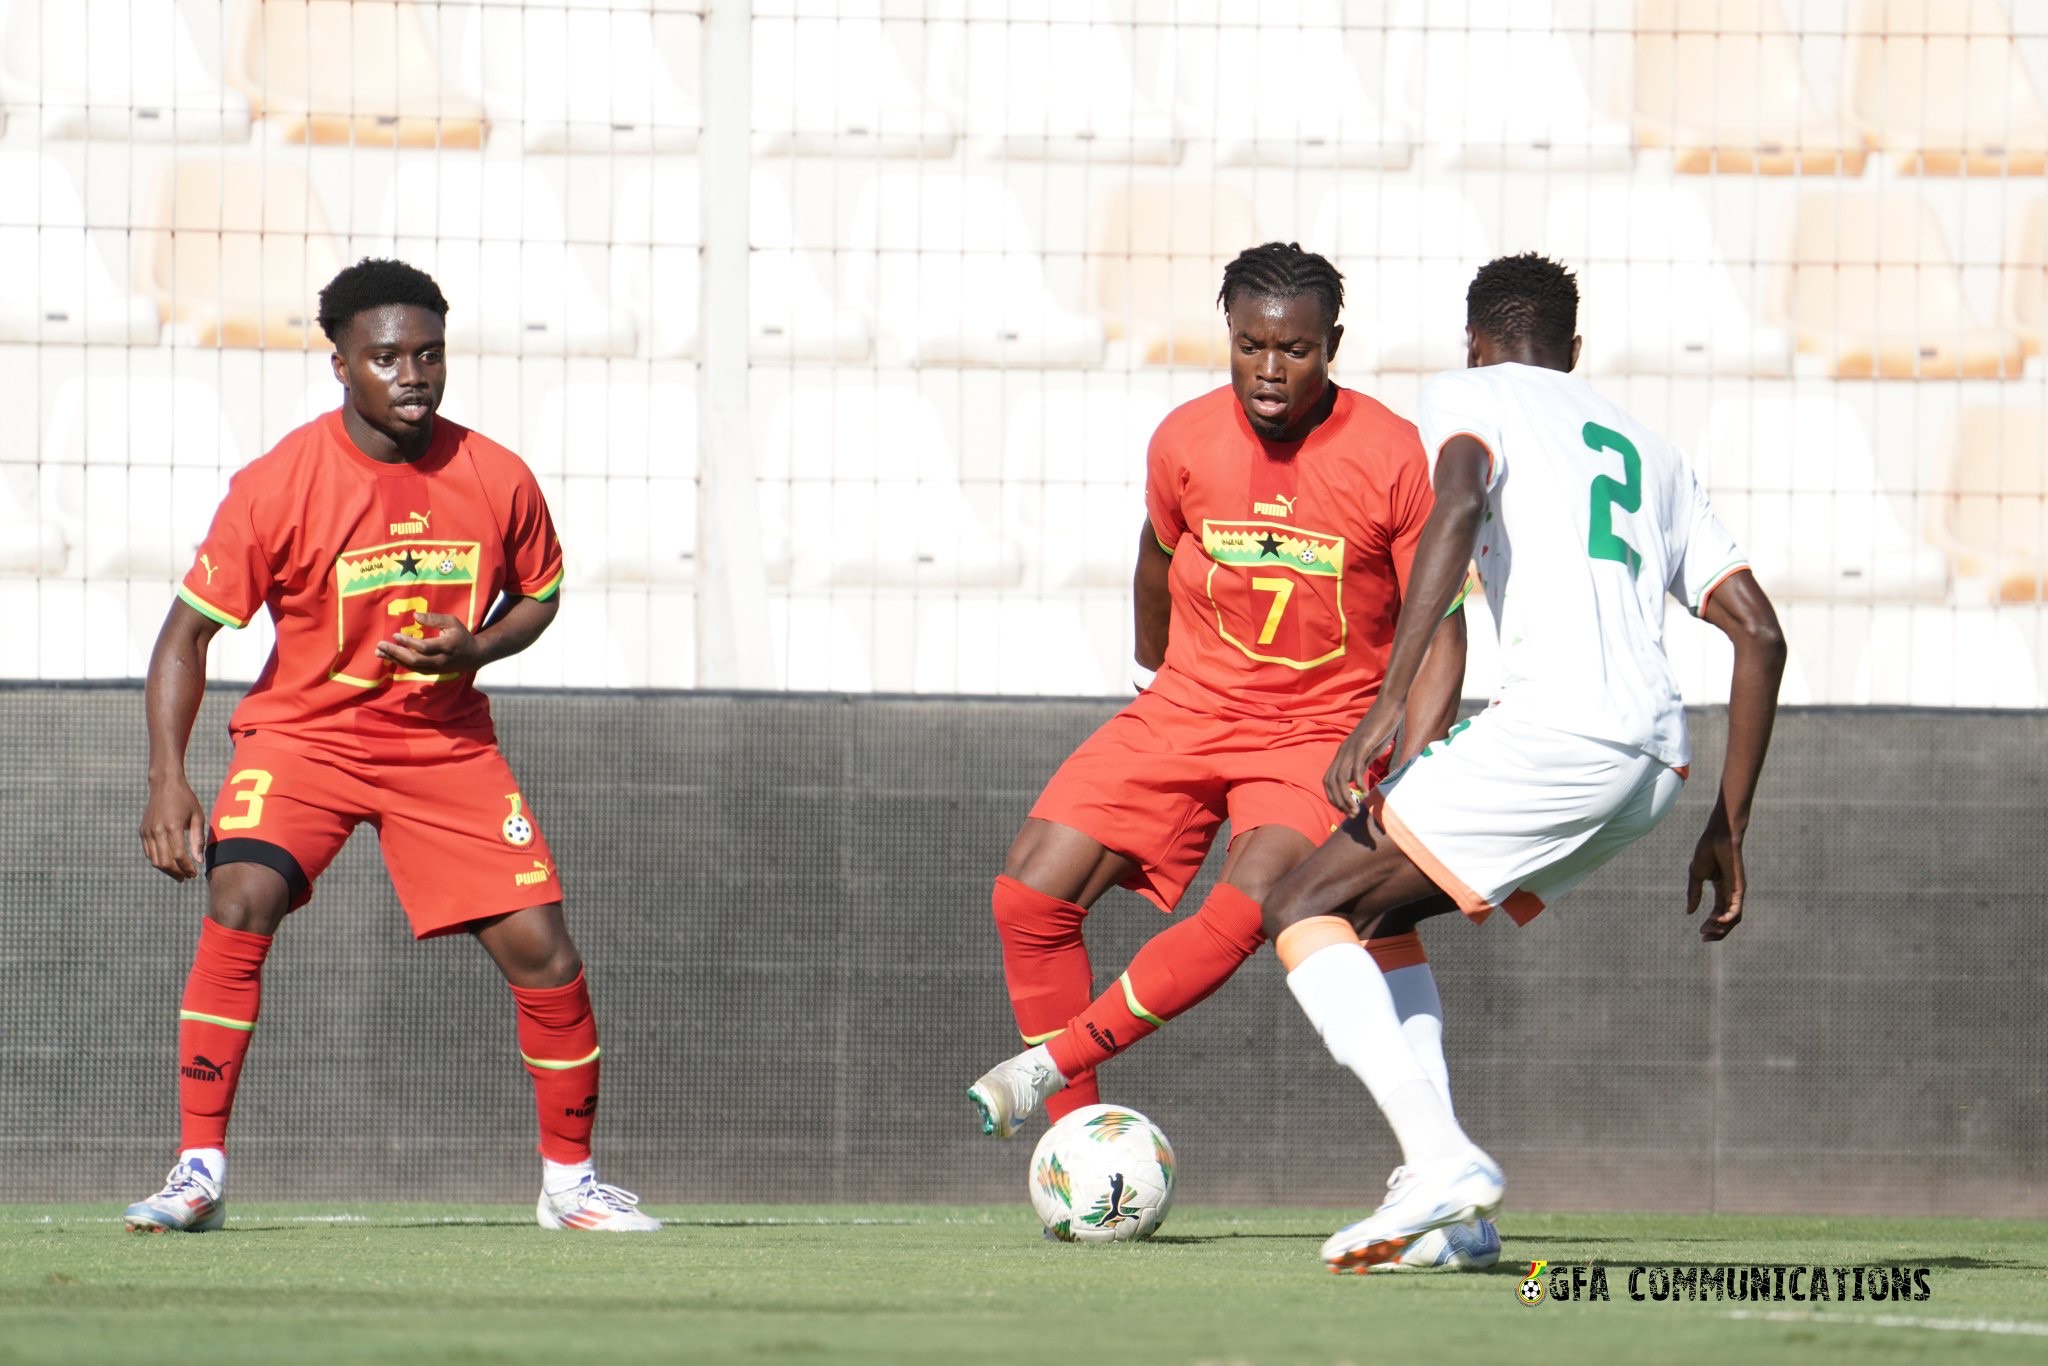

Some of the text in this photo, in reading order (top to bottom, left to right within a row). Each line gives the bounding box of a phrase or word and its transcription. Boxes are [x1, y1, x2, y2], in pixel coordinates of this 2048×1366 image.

[1253, 502, 1288, 518] PUMA
[1582, 421, 1642, 582] 2
[390, 521, 423, 536] PUMA
[1252, 576, 1295, 645] 7
[219, 769, 273, 830] 3
[515, 869, 547, 887] PUMA
[181, 1066, 216, 1081] PUMA
